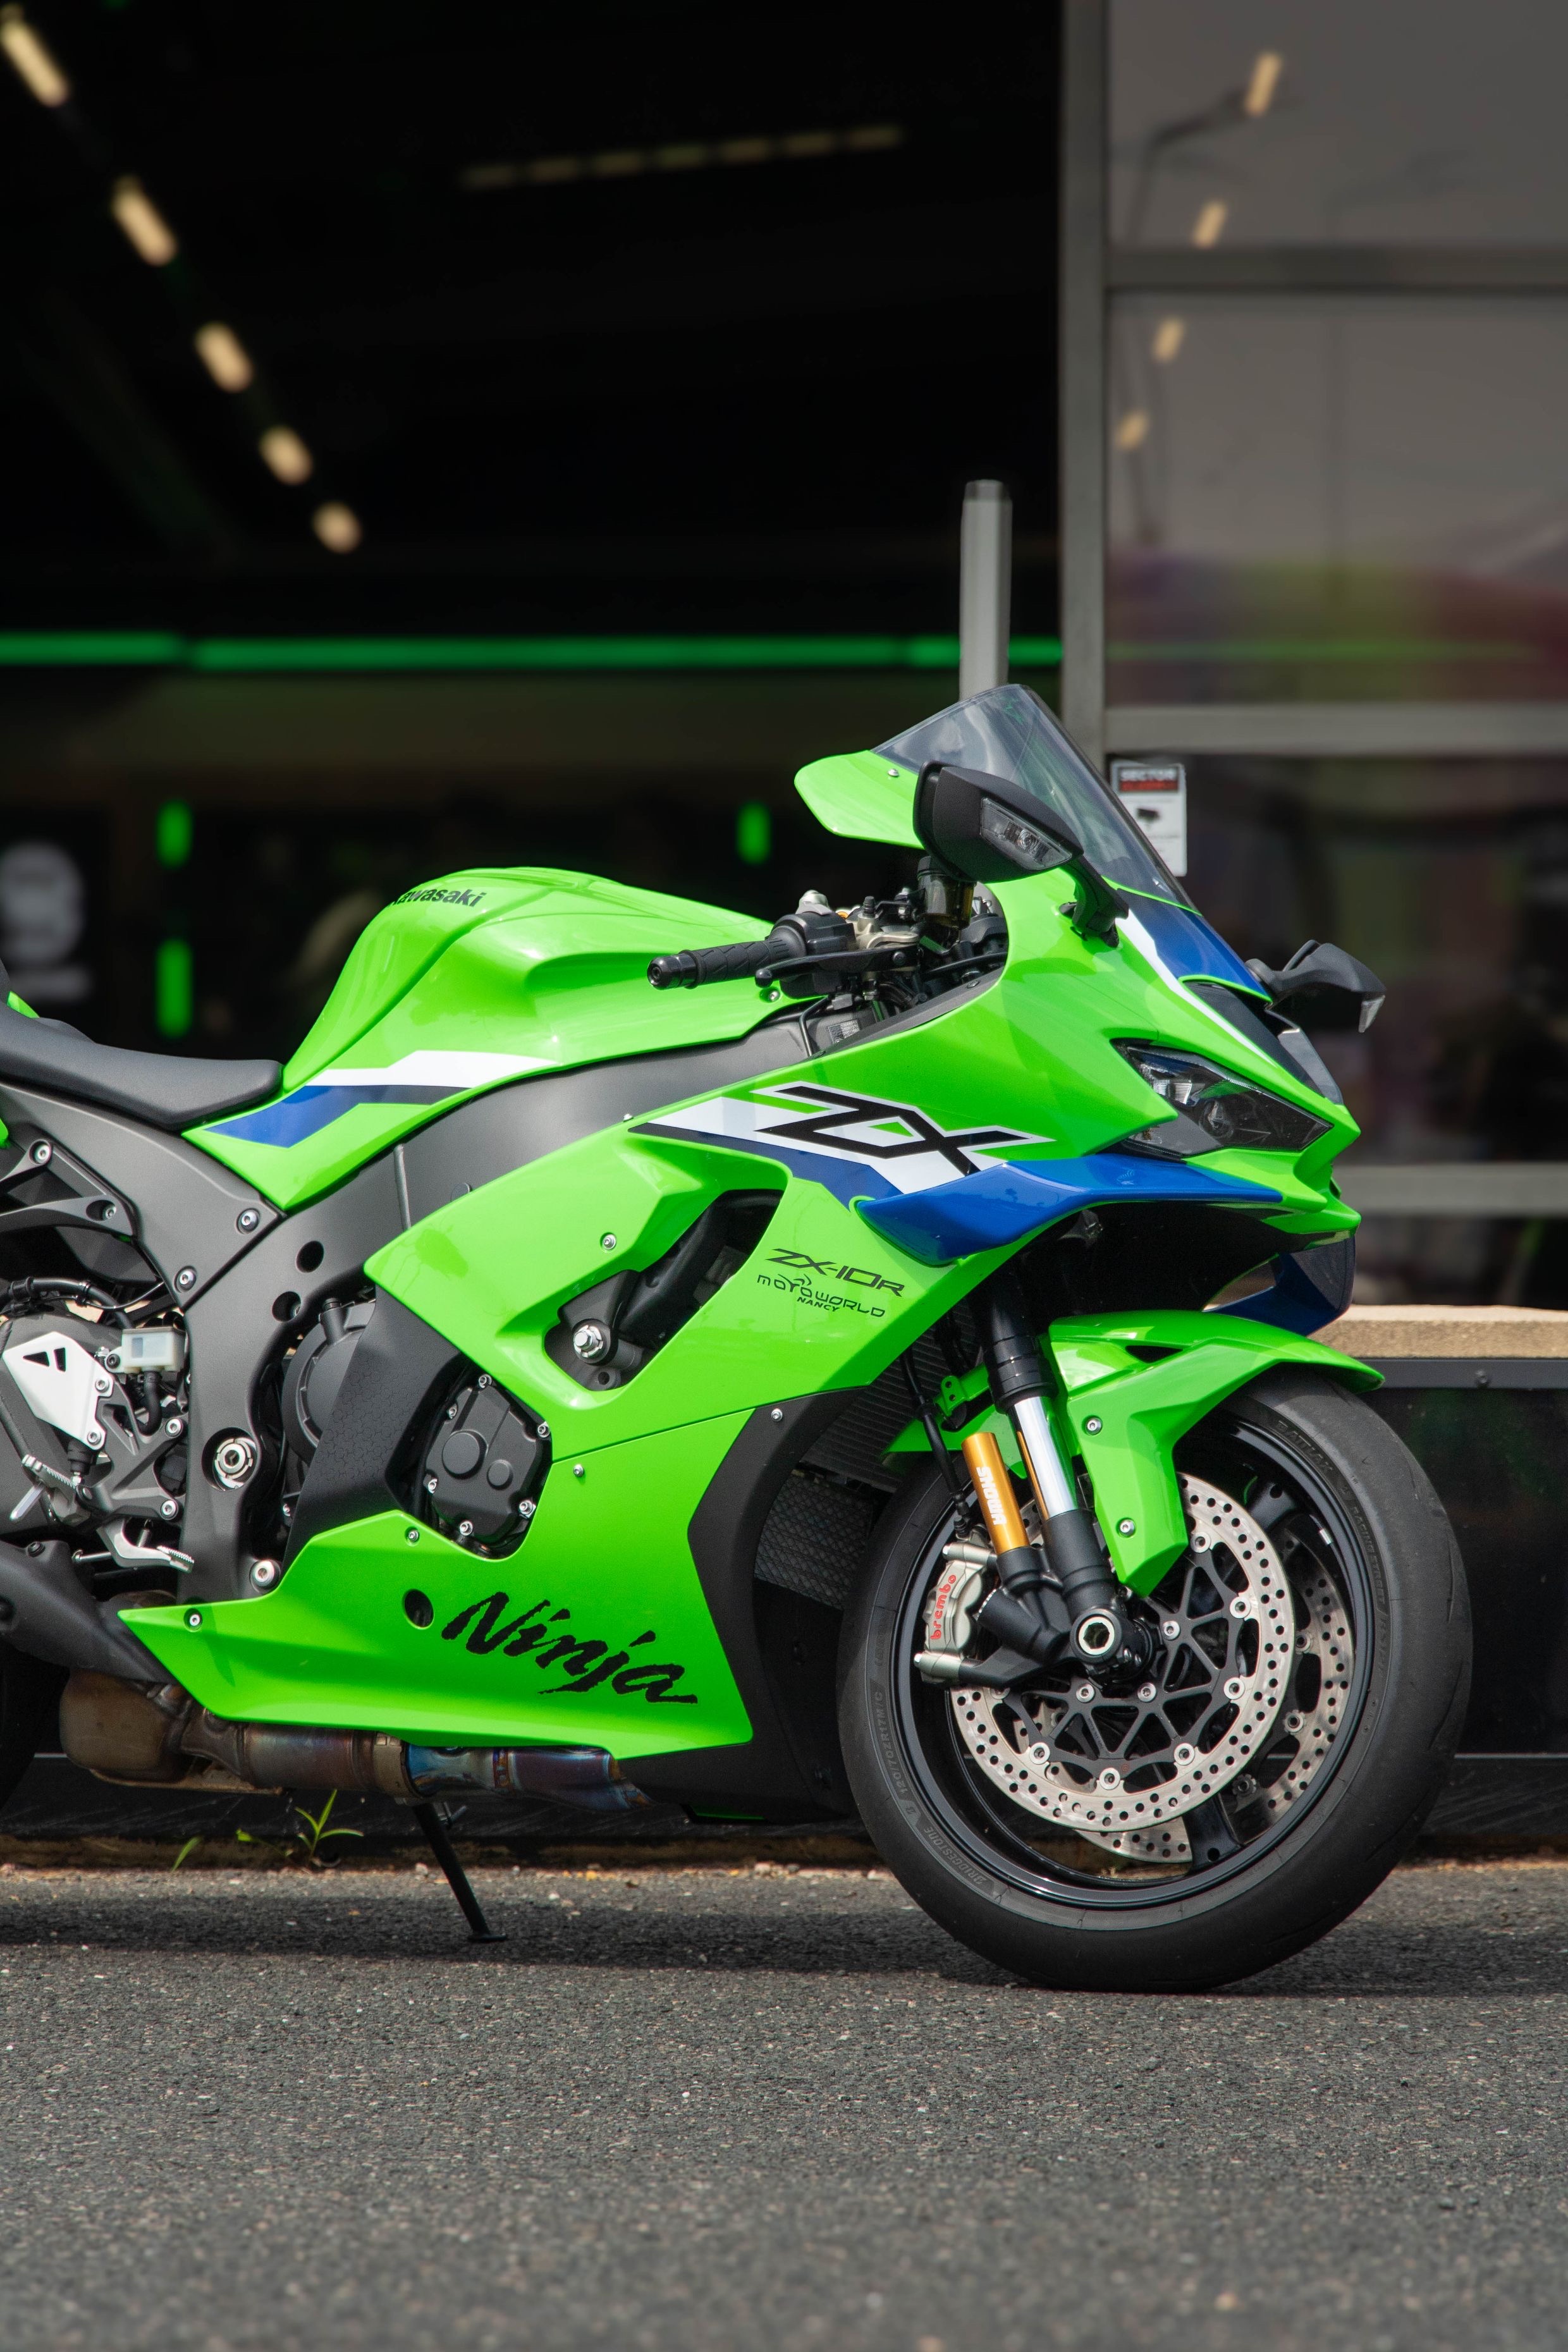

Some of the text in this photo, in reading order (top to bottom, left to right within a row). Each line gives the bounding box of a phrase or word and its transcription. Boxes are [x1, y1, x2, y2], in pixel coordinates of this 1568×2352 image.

[754, 1086, 1031, 1177] ZX
[765, 1249, 905, 1297] ZX-10R
[797, 1297, 840, 1312] NANCY
[976, 1467, 1007, 1525] SHOWA
[930, 1574, 956, 1639] brembo
[441, 1591, 698, 1704] Ninja
[924, 1827, 987, 1884] BRIDGESTONE
